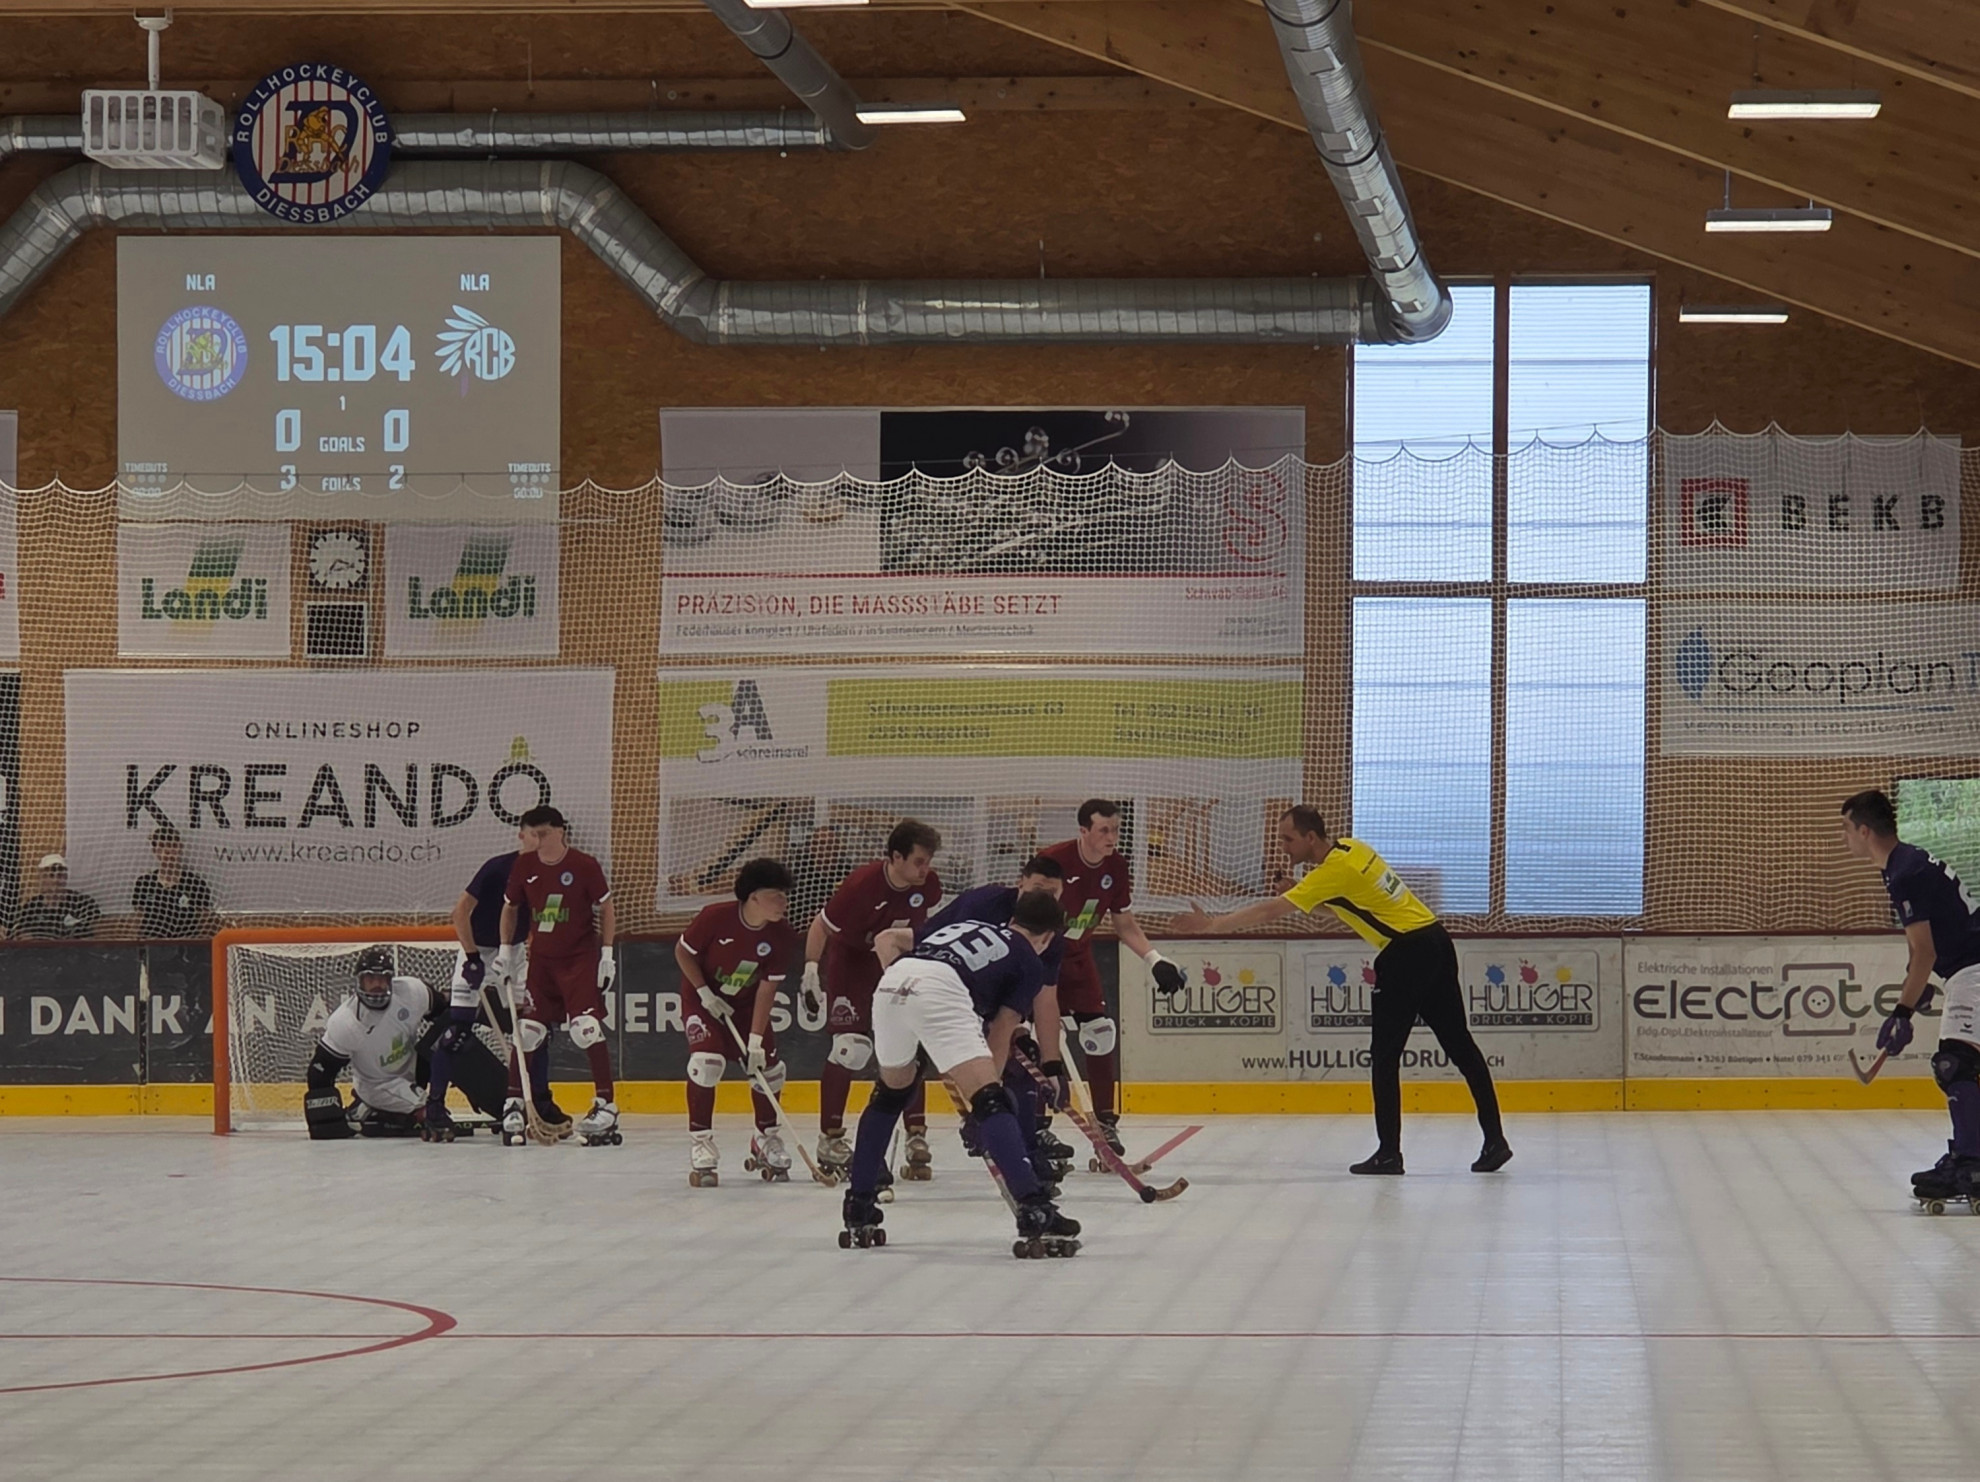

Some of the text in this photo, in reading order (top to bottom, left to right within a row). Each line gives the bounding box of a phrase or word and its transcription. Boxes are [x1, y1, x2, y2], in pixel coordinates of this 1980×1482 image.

[236, 64, 389, 143] ROLLHOCKEYCLUB
[256, 183, 370, 223] DIESSBACH
[186, 274, 216, 291] NLA
[460, 274, 490, 291] NLA
[155, 306, 248, 354] ROLLHOCKEYCLUB
[269, 324, 416, 382] 15:04
[464, 327, 516, 381] RCB
[168, 377, 237, 402] DIESSBACH
[339, 395, 346, 411] 1
[275, 409, 410, 452] 0 GOALS 0
[125, 462, 168, 473] TIMEOUTS
[279, 464, 297, 490] 3
[388, 464, 406, 490] 2
[508, 463, 551, 473] TIMEOUTS
[1781, 493, 1945, 532] BEKB
[141, 577, 267, 620] Landi
[408, 575, 536, 619] Landi
[809, 594, 844, 615] DIE
[852, 590, 985, 615] MASSSTÄBE
[993, 594, 1063, 615] SETZT
[244, 721, 421, 739] ONLINESHOP
[126, 762, 552, 830] KREANDO
[213, 839, 442, 863] www.kreando.ch
[1637, 961, 1774, 976] Elektrische Installationen
[30, 994, 184, 1036] DANK
[1154, 1016, 1207, 1028] DRUCK
[1229, 1015, 1275, 1028] KOPIE
[1312, 1015, 1365, 1028] DRUCK
[1471, 1014, 1524, 1026] DRUCK
[1546, 1013, 1592, 1026] KOPIE
